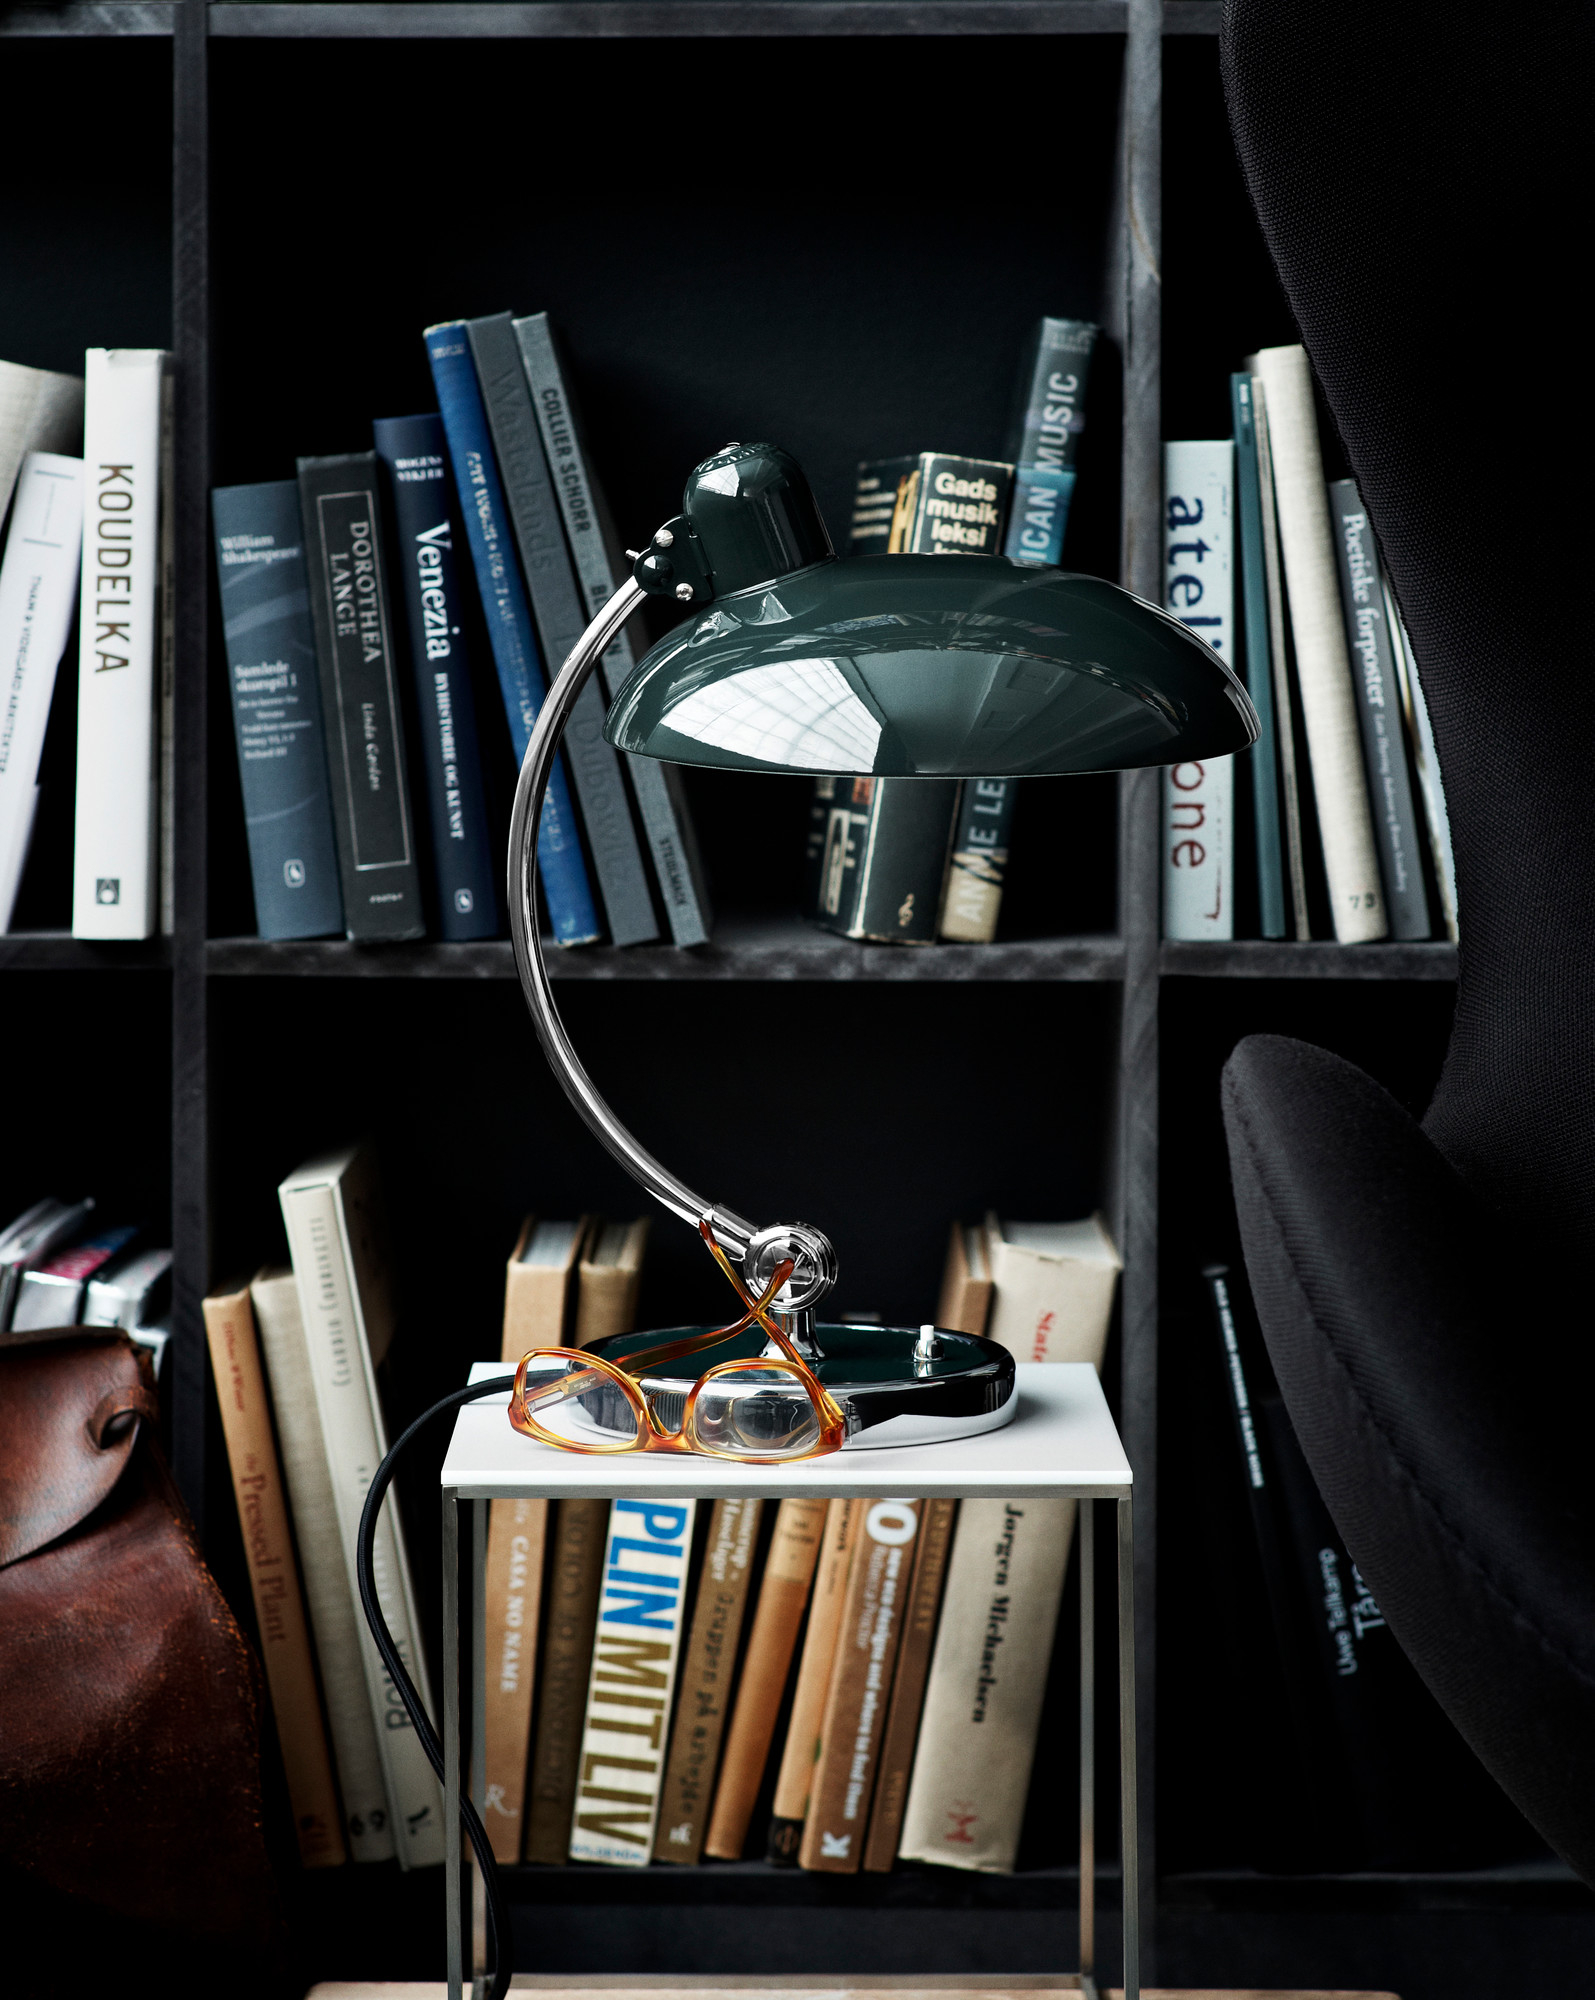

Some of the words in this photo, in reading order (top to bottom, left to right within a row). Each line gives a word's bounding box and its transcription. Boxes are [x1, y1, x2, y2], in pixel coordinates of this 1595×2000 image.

[541, 388, 574, 454] COLLIER
[559, 454, 592, 532] SCHORR
[1034, 371, 1080, 476] MUSIC
[926, 498, 998, 526] musik
[934, 473, 998, 502] Gads
[1019, 485, 1060, 561] ICAN
[95, 463, 134, 674] KOUDELKA
[931, 519, 987, 548] leksi
[1167, 494, 1223, 650] atel
[1342, 513, 1373, 605] Poetiske
[330, 551, 358, 638] LANGE
[350, 520, 383, 665] DOROTHEA
[415, 521, 461, 660] Venezia
[1352, 608, 1386, 707] forposter
[446, 788, 465, 839] KUNST
[1171, 761, 1206, 870] one
[240, 1470, 282, 1569] Pressed
[508, 1535, 529, 1590] CASA
[259, 1573, 289, 1645] Plant
[602, 1500, 689, 1631] PLIN
[1317, 1546, 1348, 1630] Tellkamp
[504, 1595, 524, 1628] NO
[1334, 1630, 1358, 1676] Uwe
[500, 1630, 521, 1693] NAME
[972, 1594, 1011, 1724] Michaelsen
